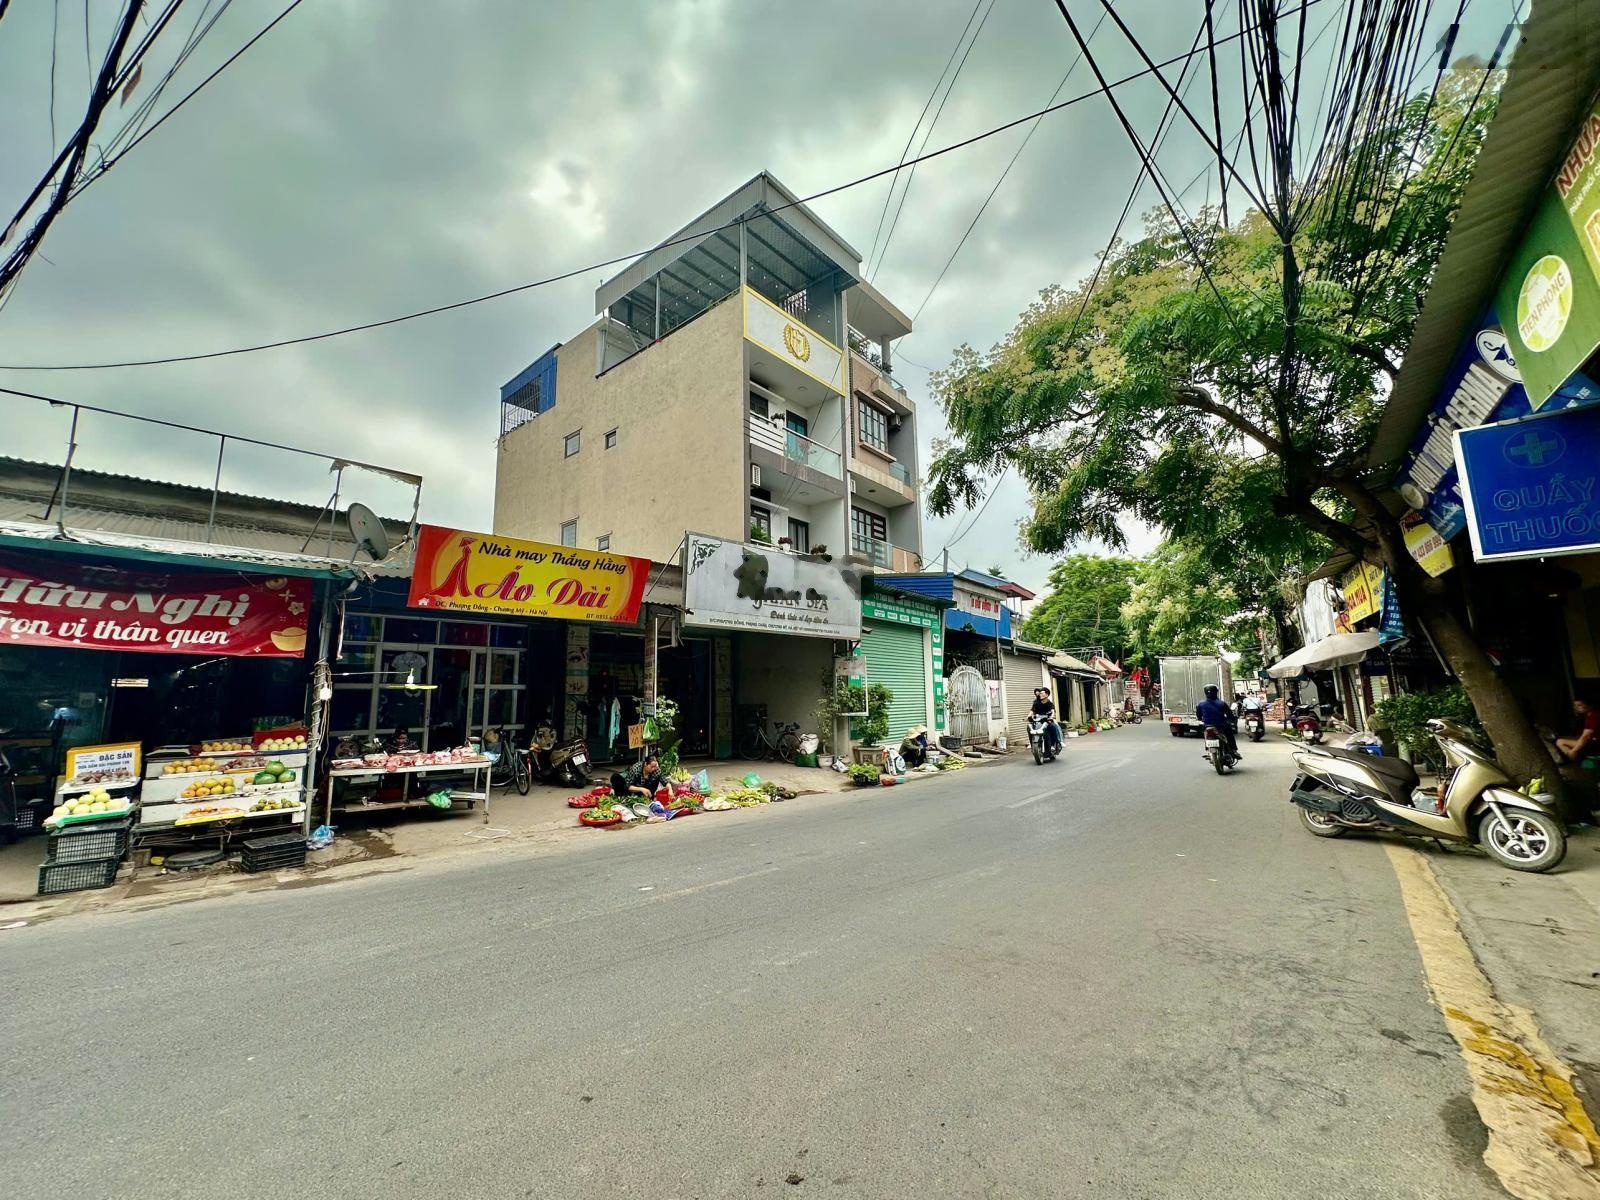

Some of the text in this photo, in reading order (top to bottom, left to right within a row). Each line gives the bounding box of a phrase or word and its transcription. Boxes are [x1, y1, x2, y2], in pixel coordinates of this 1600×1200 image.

[1445, 363, 1509, 428] GERMA
[478, 541, 626, 574] Nhà may Thắng Hằng
[0, 577, 250, 626] Hữu Nghị
[474, 565, 611, 609] Áo Dài
[58, 618, 88, 644] vị
[92, 620, 161, 643] thân
[165, 627, 230, 649] quen
[117, 750, 133, 759] SẢN
